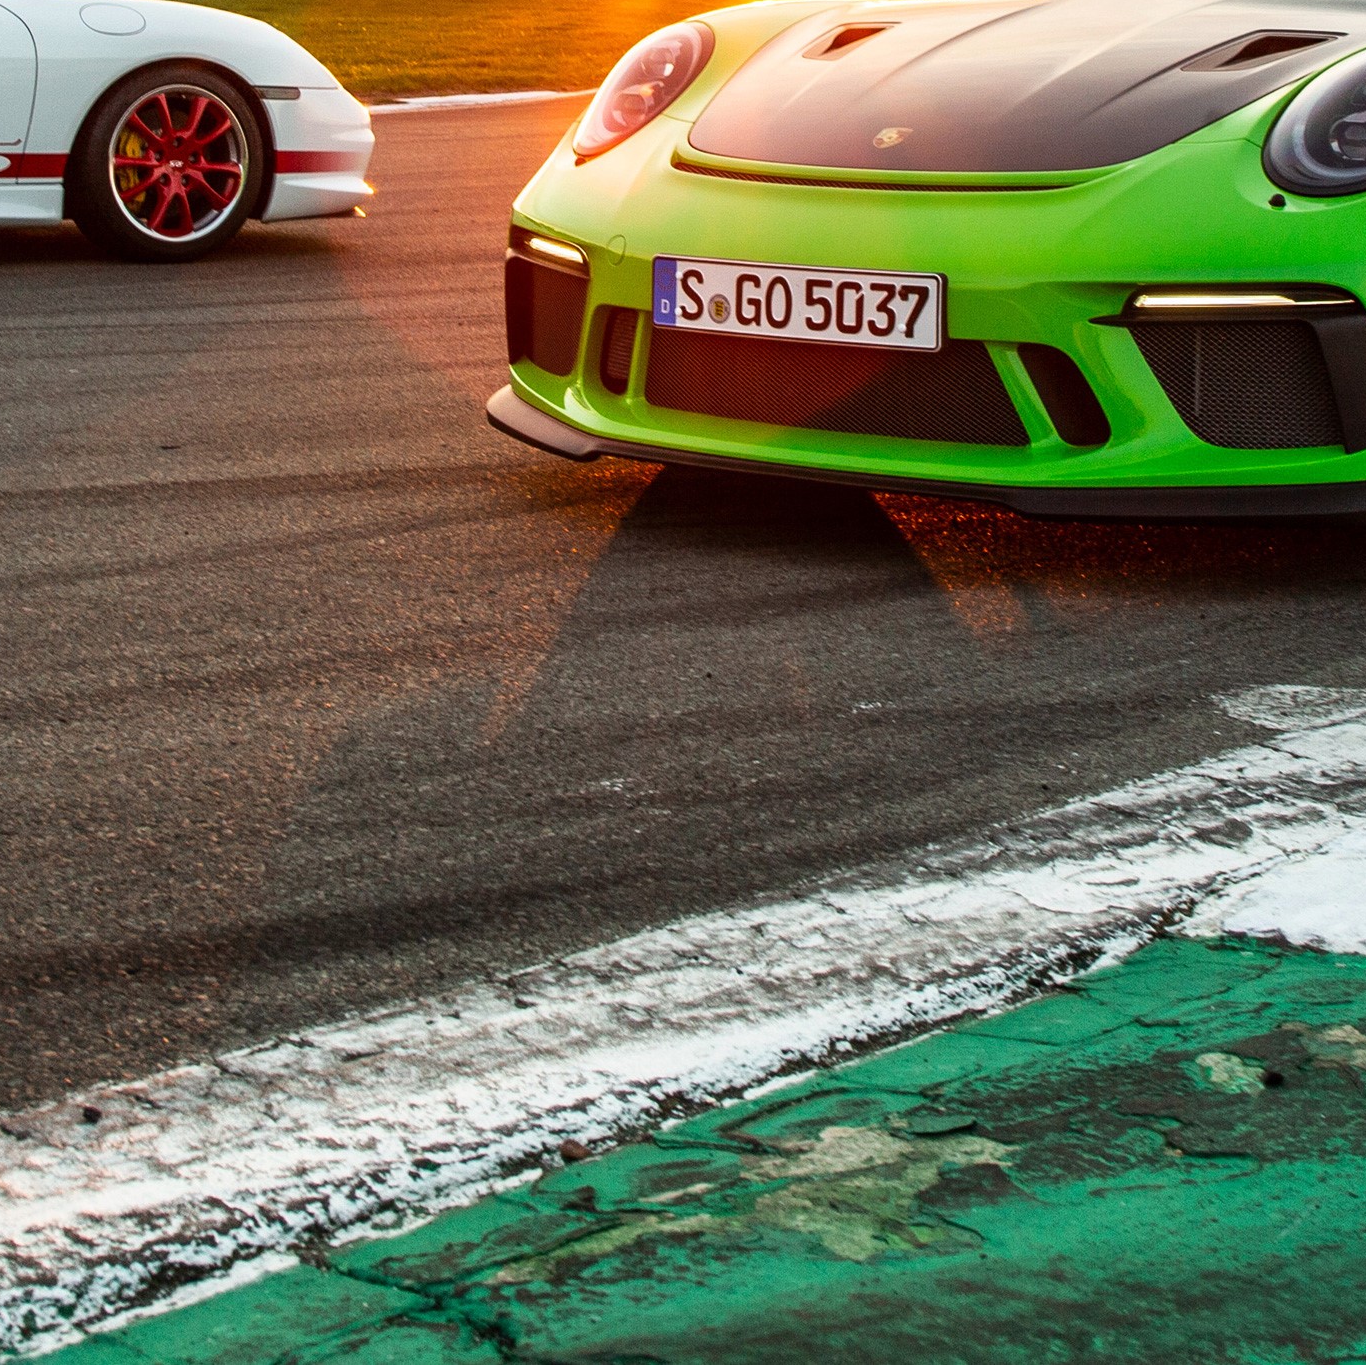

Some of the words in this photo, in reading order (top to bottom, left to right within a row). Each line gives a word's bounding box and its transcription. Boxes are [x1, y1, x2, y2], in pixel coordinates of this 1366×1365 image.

[661, 298, 670, 314] D
[680, 269, 704, 321] S
[735, 273, 792, 329] GO
[804, 278, 930, 339] 5037
